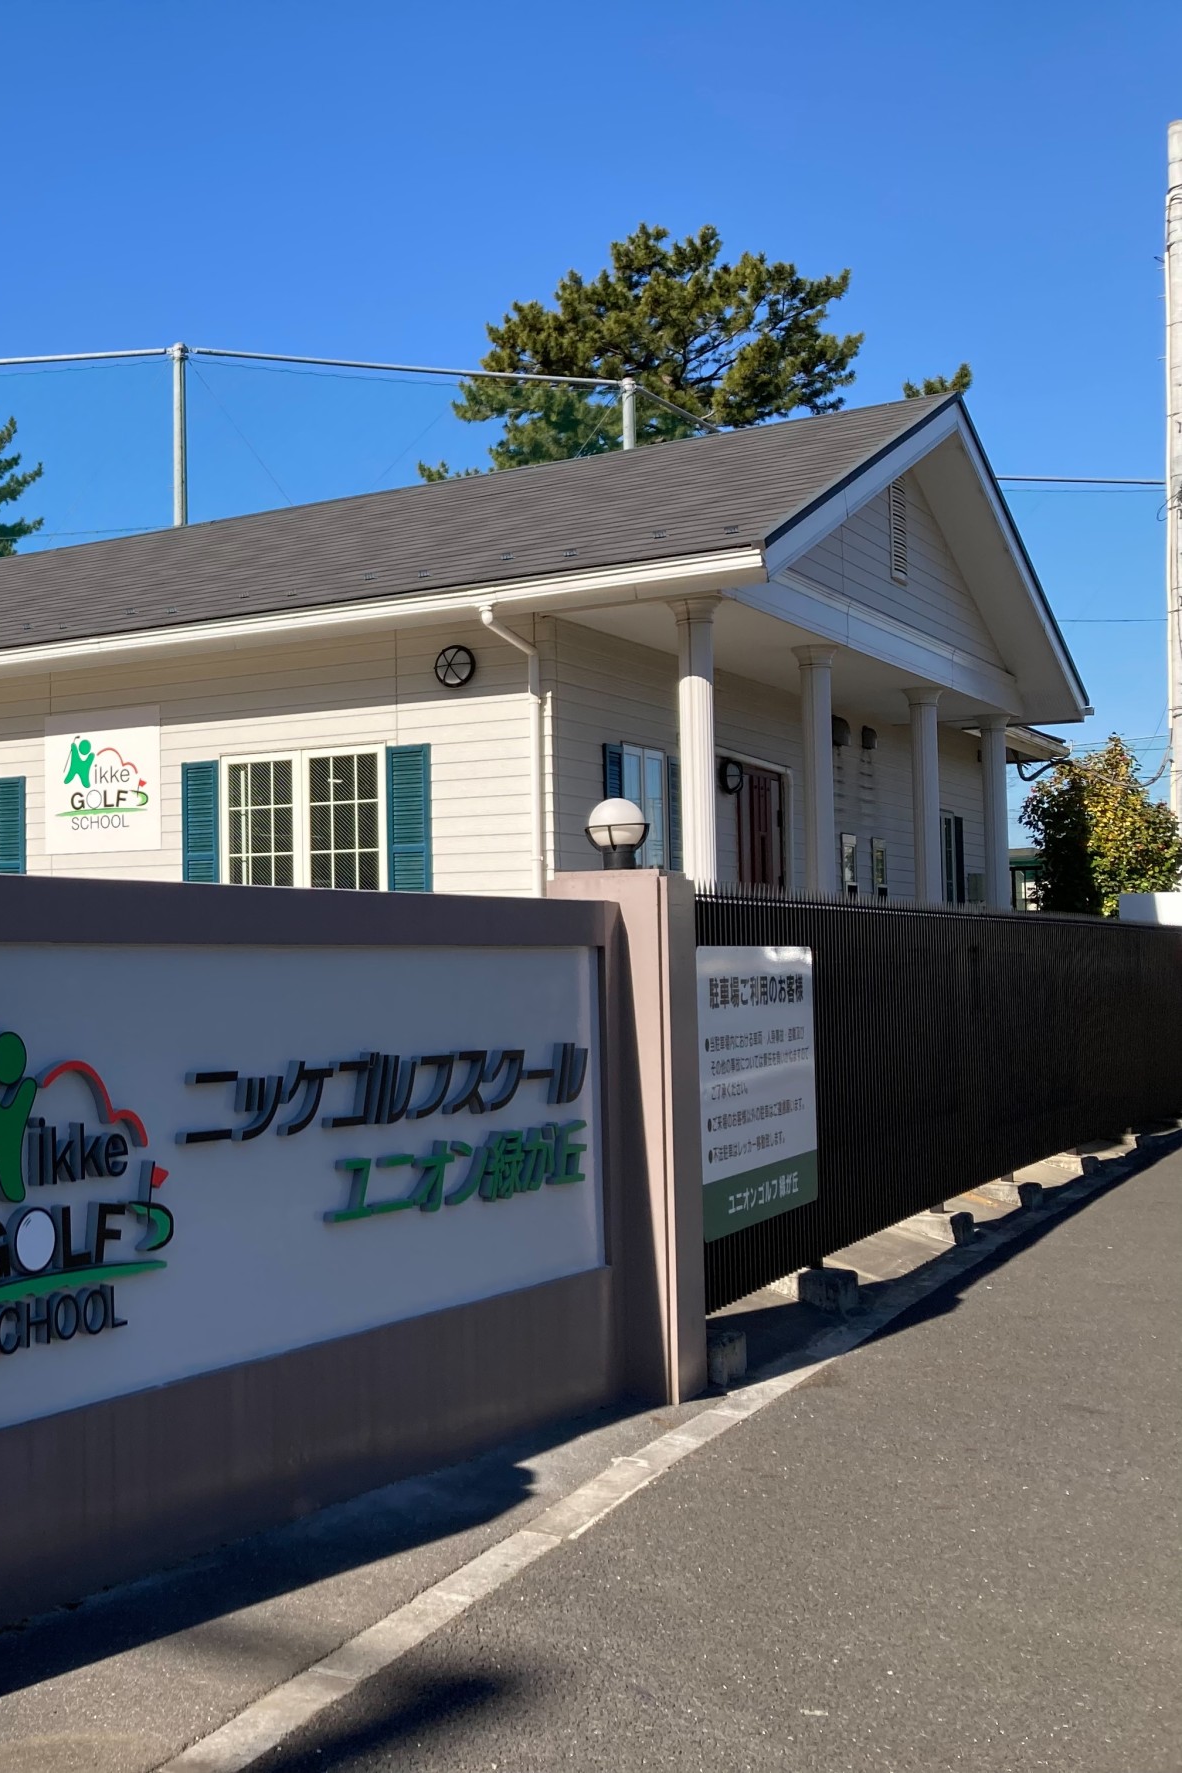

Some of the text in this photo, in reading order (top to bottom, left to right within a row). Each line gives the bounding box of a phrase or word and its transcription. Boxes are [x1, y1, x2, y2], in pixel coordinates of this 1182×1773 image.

[70, 789, 129, 811] GOLF
[71, 814, 129, 831] SCHOOL
[708, 974, 804, 1009] 駐車場ご利用のお客様
[175, 1043, 589, 1144] ニッケゴルフスクール
[323, 1119, 588, 1223] ユニオン緑が丘
